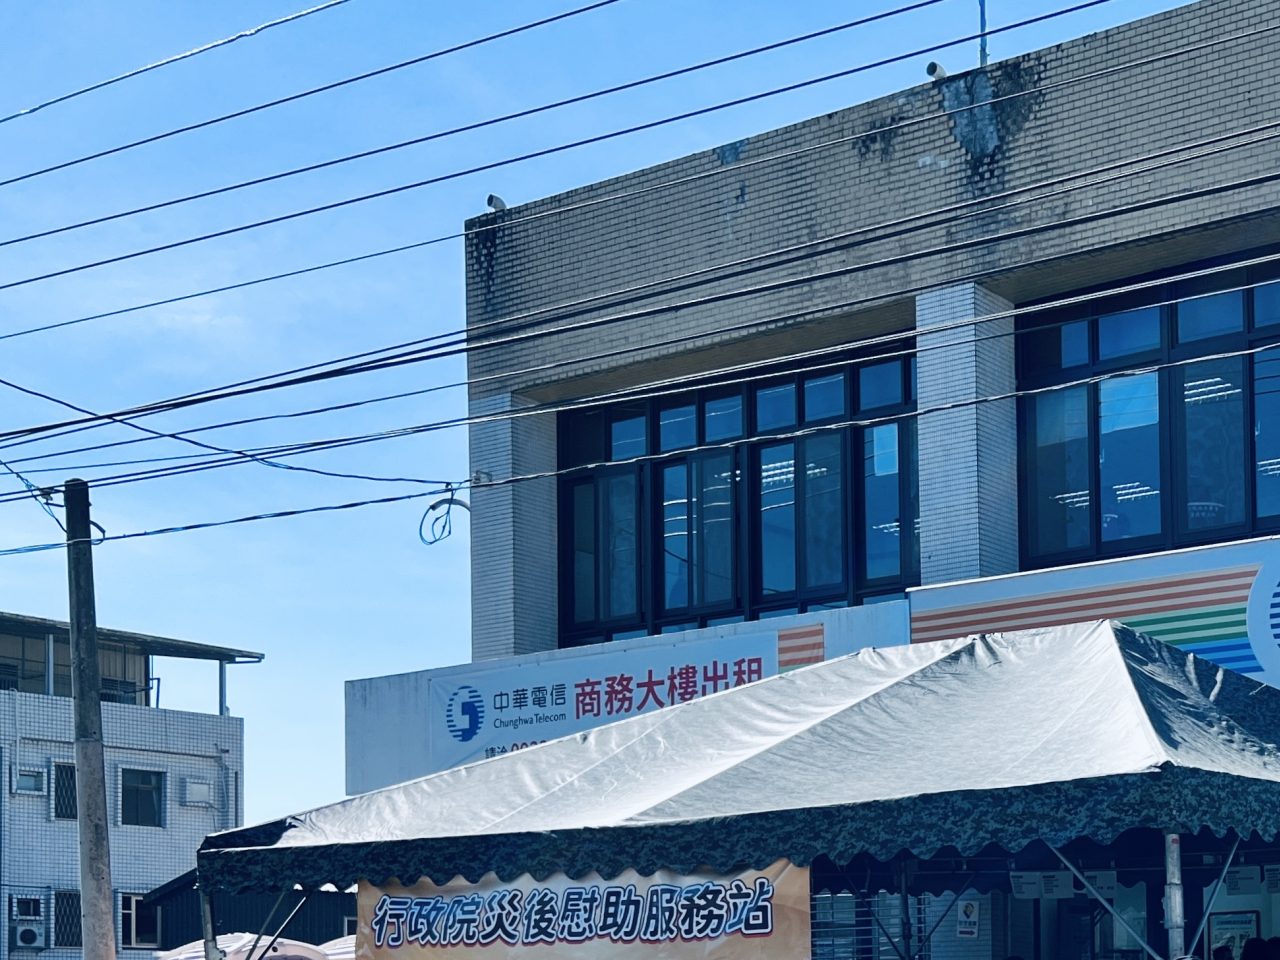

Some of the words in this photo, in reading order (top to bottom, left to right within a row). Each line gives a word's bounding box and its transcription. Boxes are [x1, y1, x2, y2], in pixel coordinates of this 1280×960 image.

[493, 683, 567, 713] 中華電信
[574, 656, 763, 721] 商務大樓出租
[493, 715, 534, 730] Chunghwa
[534, 712, 567, 724] Telecom
[372, 876, 774, 948] 行政院災後慰助服務站
